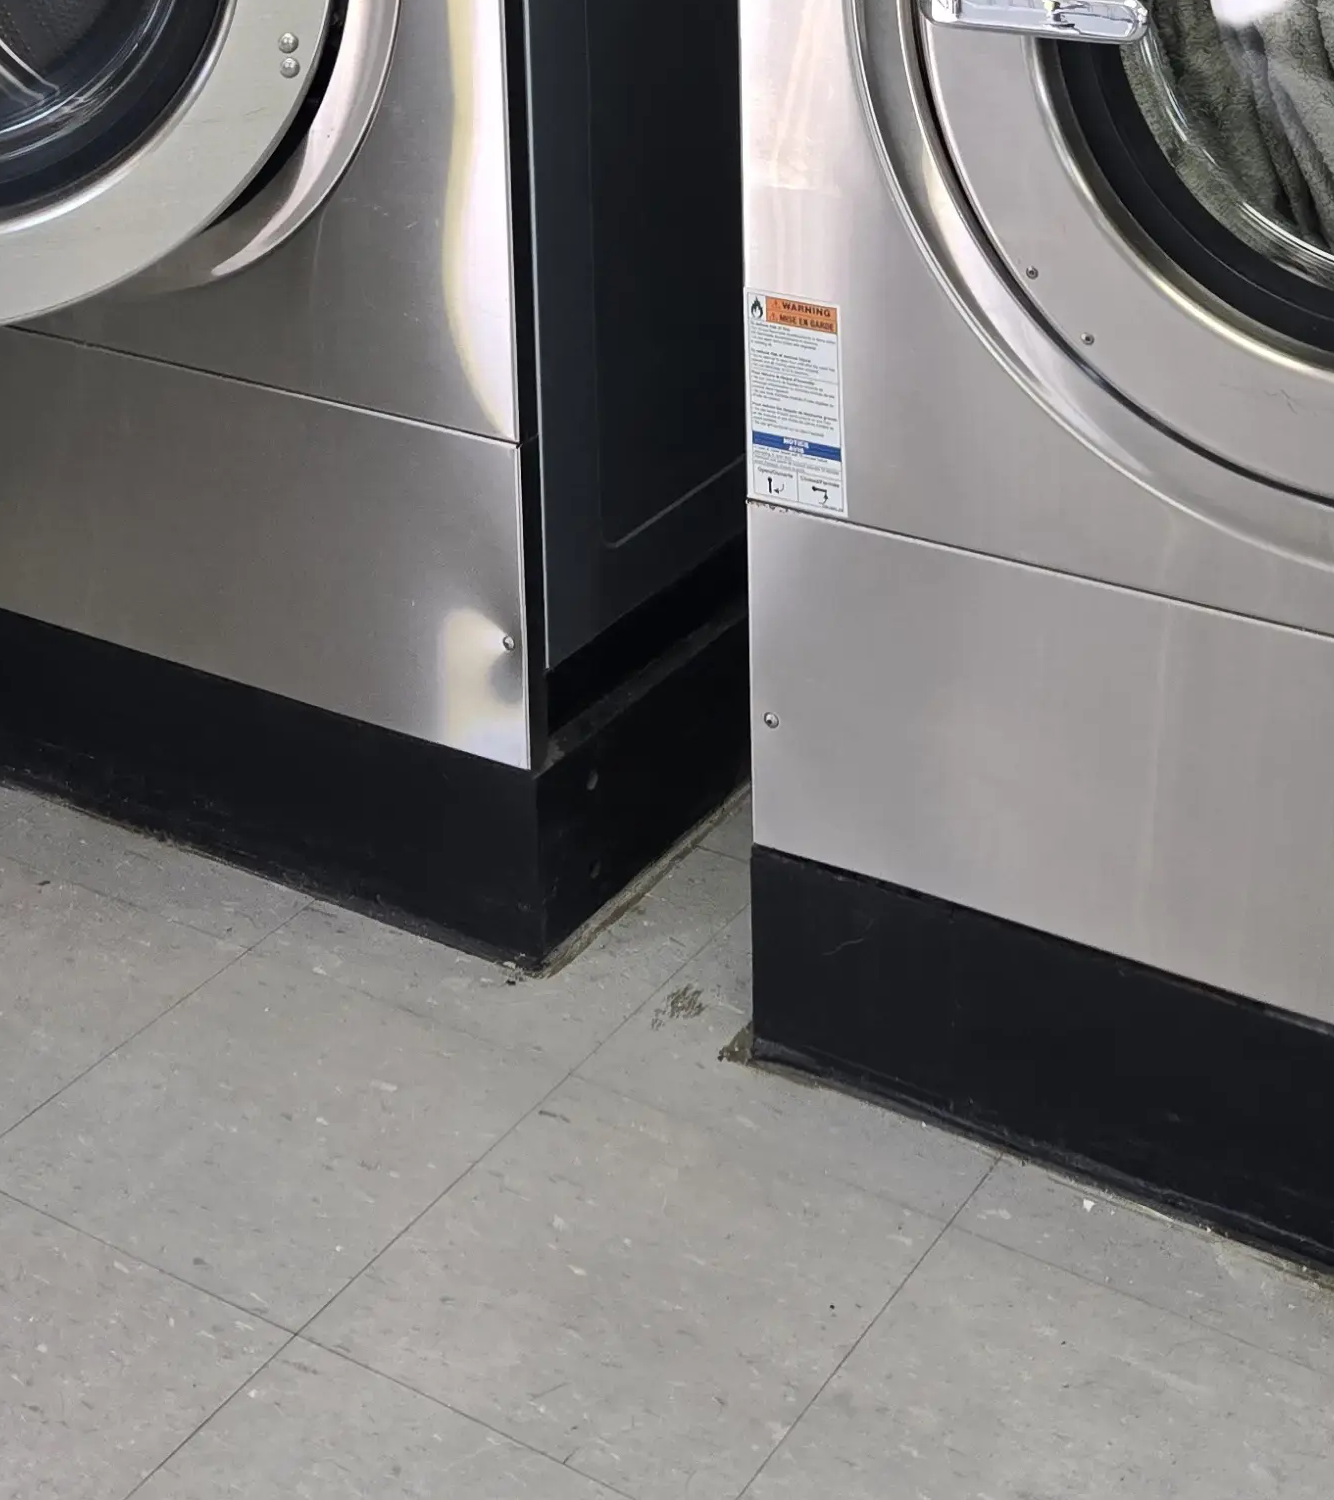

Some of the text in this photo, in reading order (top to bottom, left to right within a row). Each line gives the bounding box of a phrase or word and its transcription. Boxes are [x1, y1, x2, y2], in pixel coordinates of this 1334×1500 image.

[782, 302, 831, 317] WARNING
[779, 314, 834, 331] MISE EN GARDE
